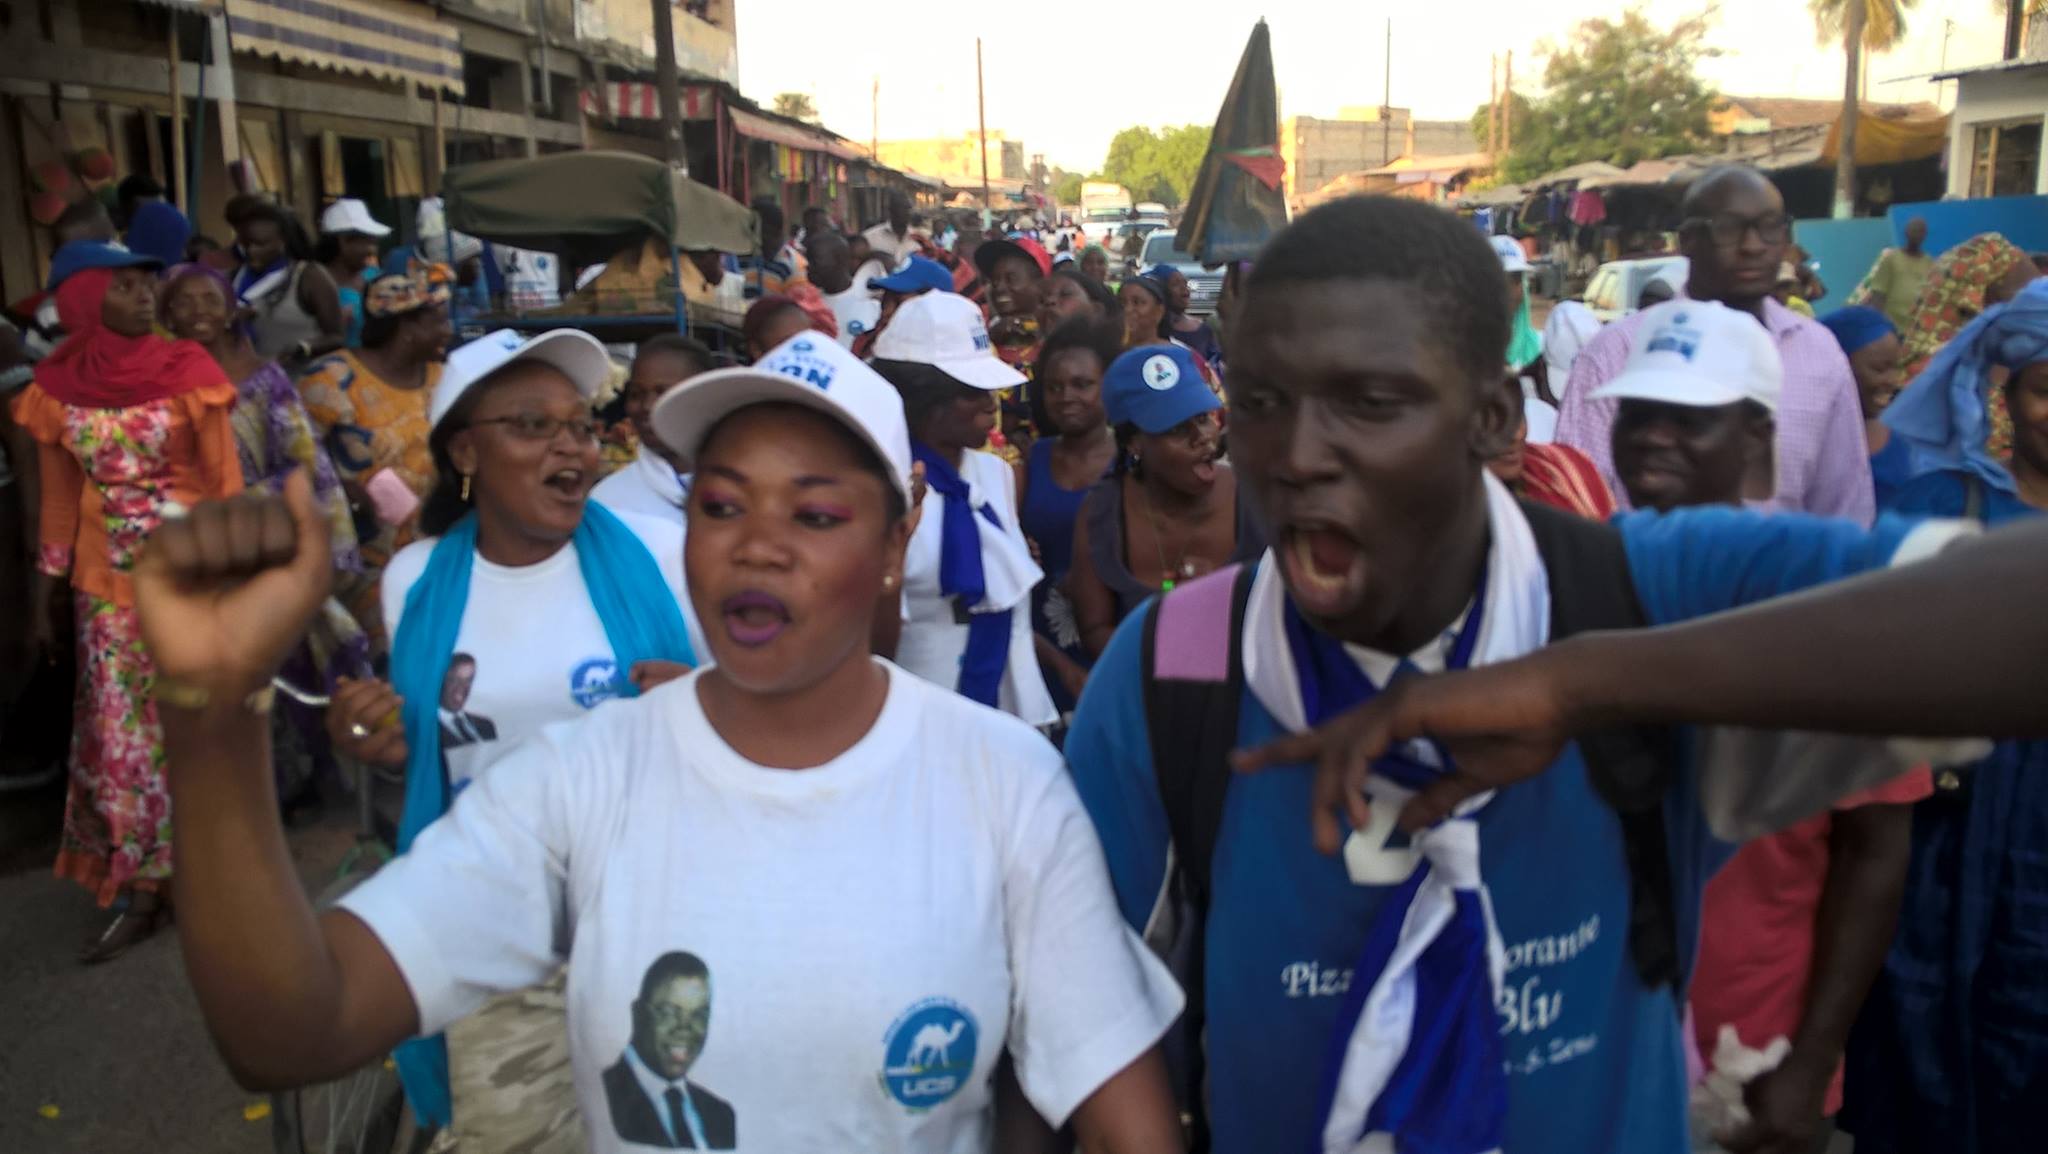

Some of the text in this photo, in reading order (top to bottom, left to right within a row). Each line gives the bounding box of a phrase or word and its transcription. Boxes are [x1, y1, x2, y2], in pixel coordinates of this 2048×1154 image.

[1281, 915, 1599, 998] Pizz orante
[902, 1076, 956, 1097] UCS
